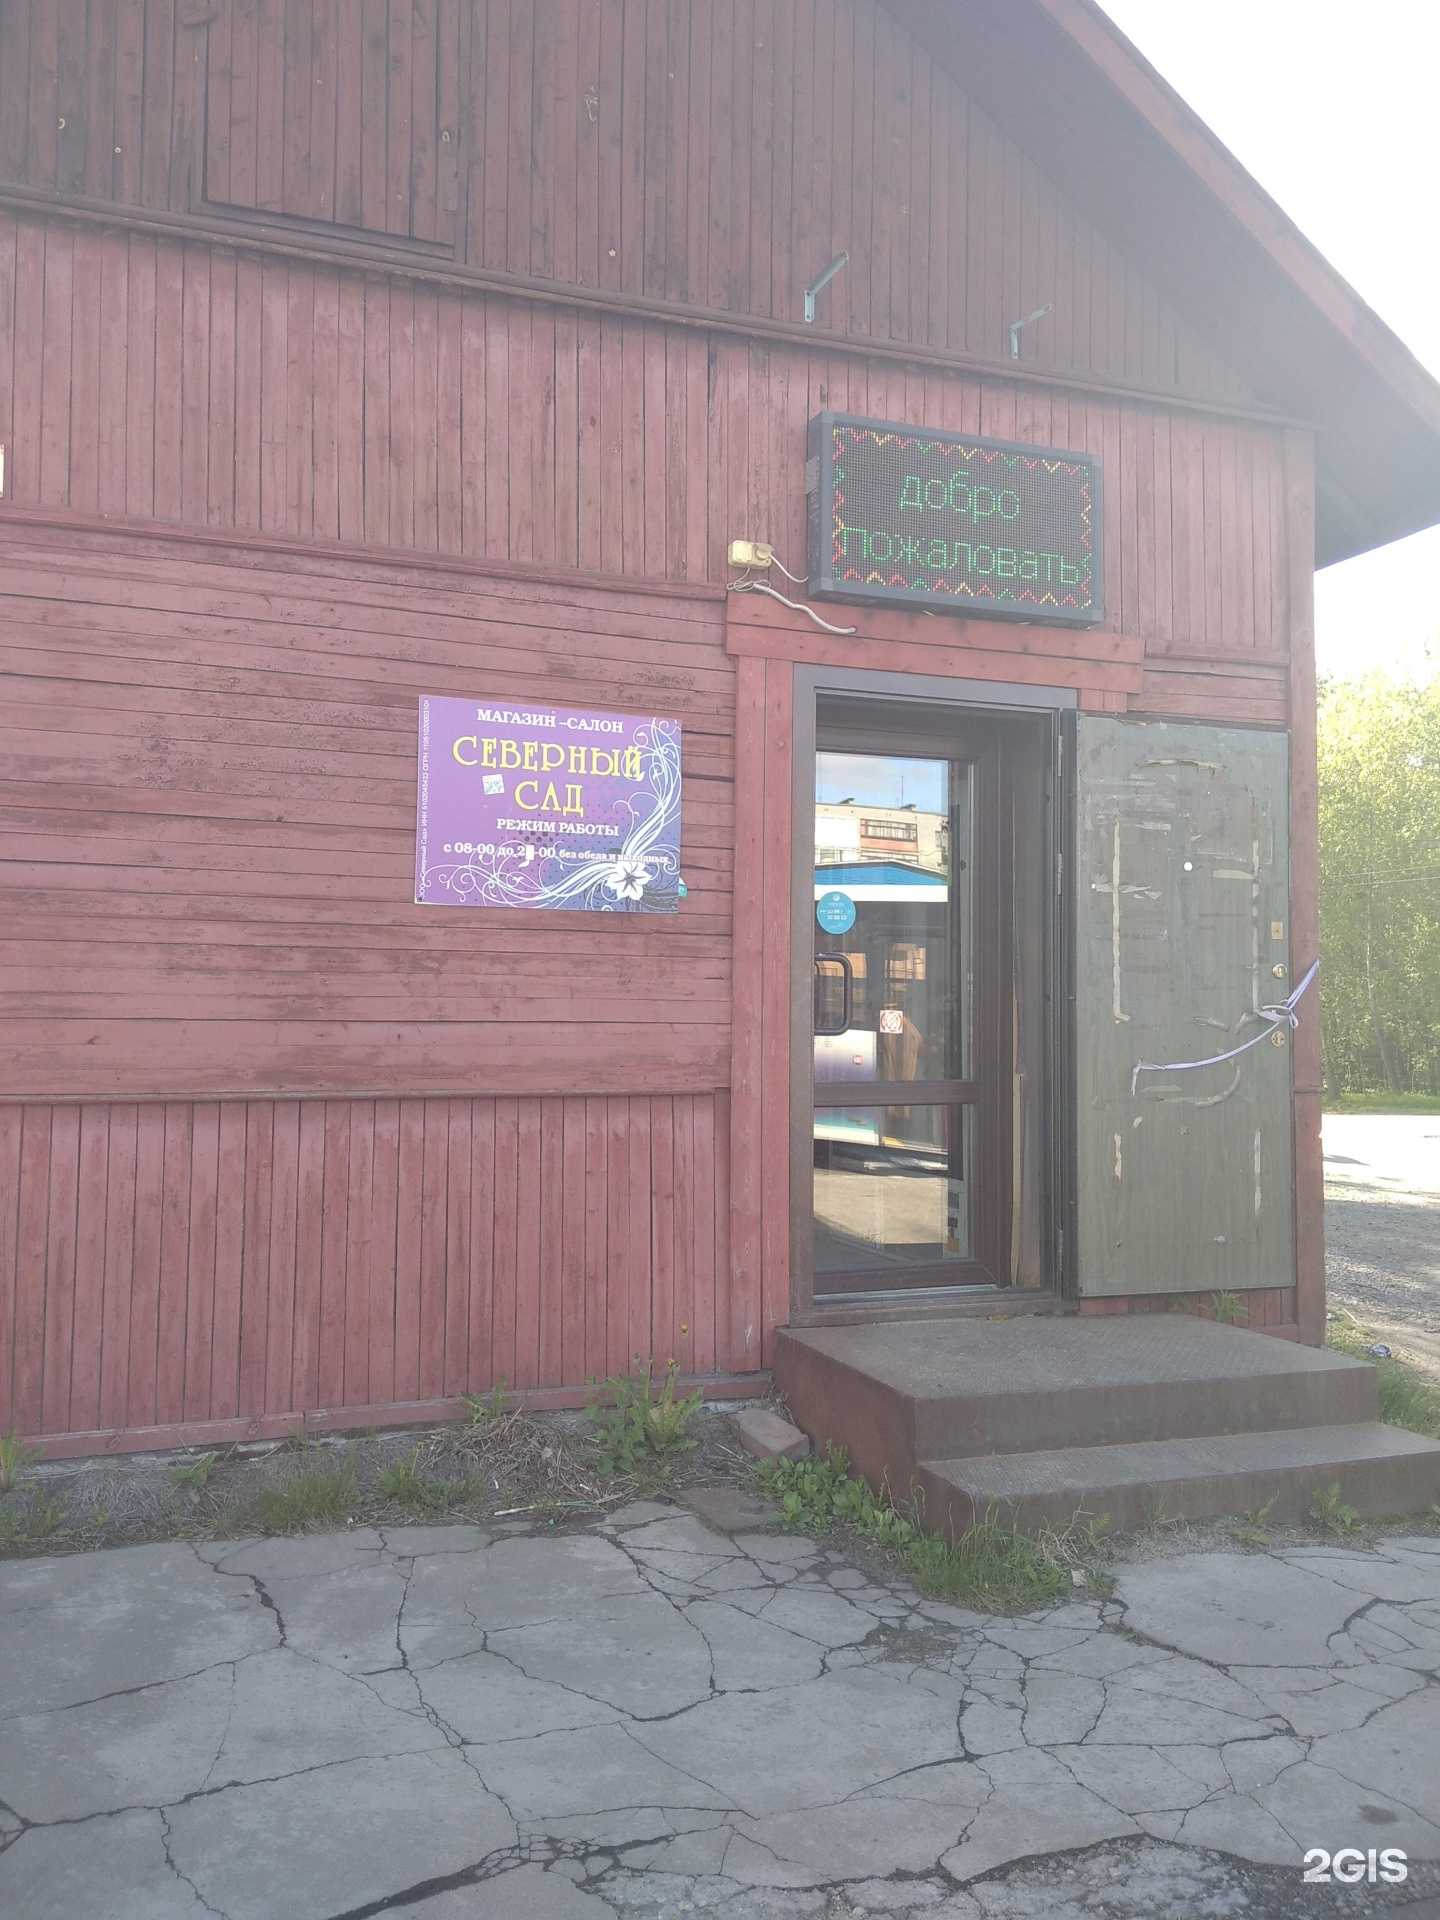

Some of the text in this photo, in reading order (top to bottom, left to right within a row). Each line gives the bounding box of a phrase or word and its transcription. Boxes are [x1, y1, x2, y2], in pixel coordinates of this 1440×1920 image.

[477, 708, 556, 728] МАГАЗИН
[452, 735, 643, 779] СЕВЕРНЫЙ
[514, 780, 584, 817] САД
[496, 818, 620, 836] РЕЖИМ РАБОТЫ
[443, 843, 452, 853] с
[454, 842, 495, 855] 08-00
[497, 846, 514, 857] до
[517, 845, 556, 860] 2-00
